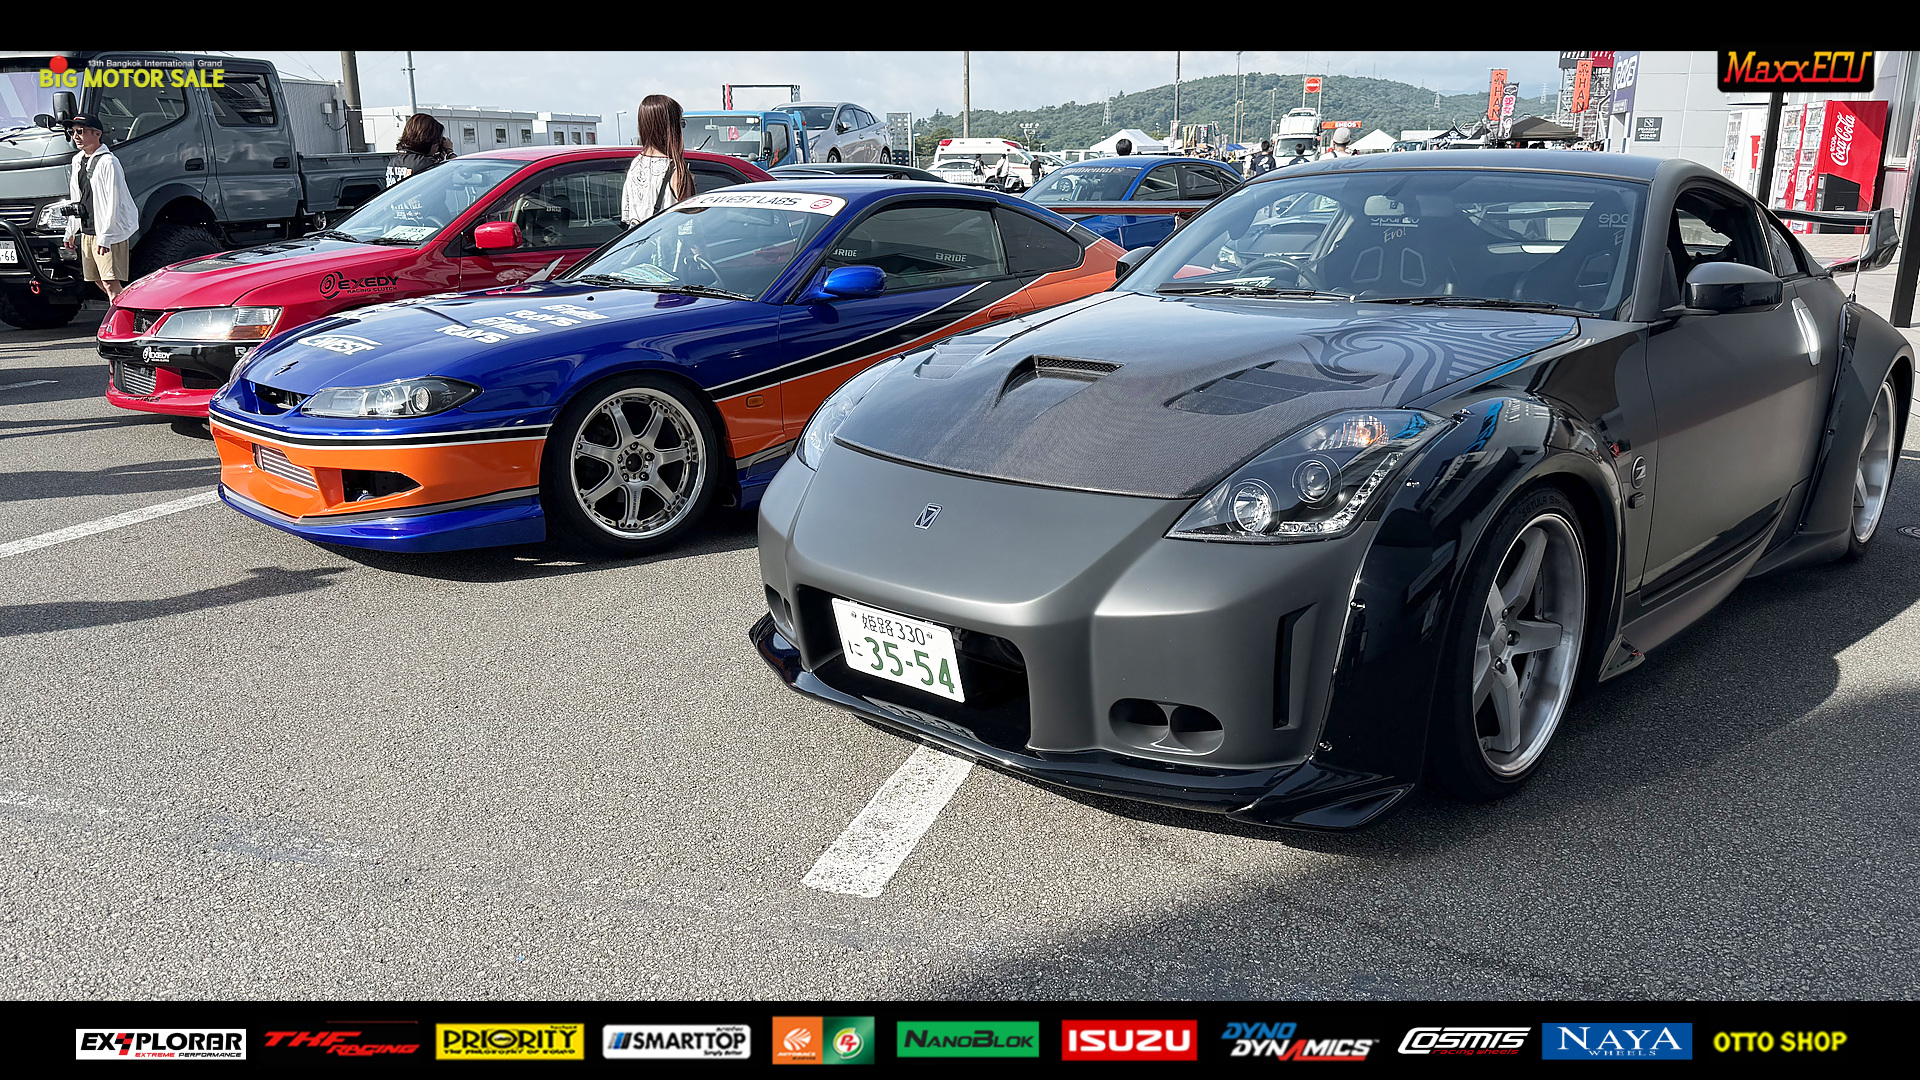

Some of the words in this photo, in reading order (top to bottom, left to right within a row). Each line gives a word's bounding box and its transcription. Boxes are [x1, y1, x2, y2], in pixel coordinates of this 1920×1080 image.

[935, 252, 967, 262] BRIDE
[338, 275, 399, 290] EXEDY
[848, 640, 863, 656] に
[864, 636, 955, 694] 35-54
